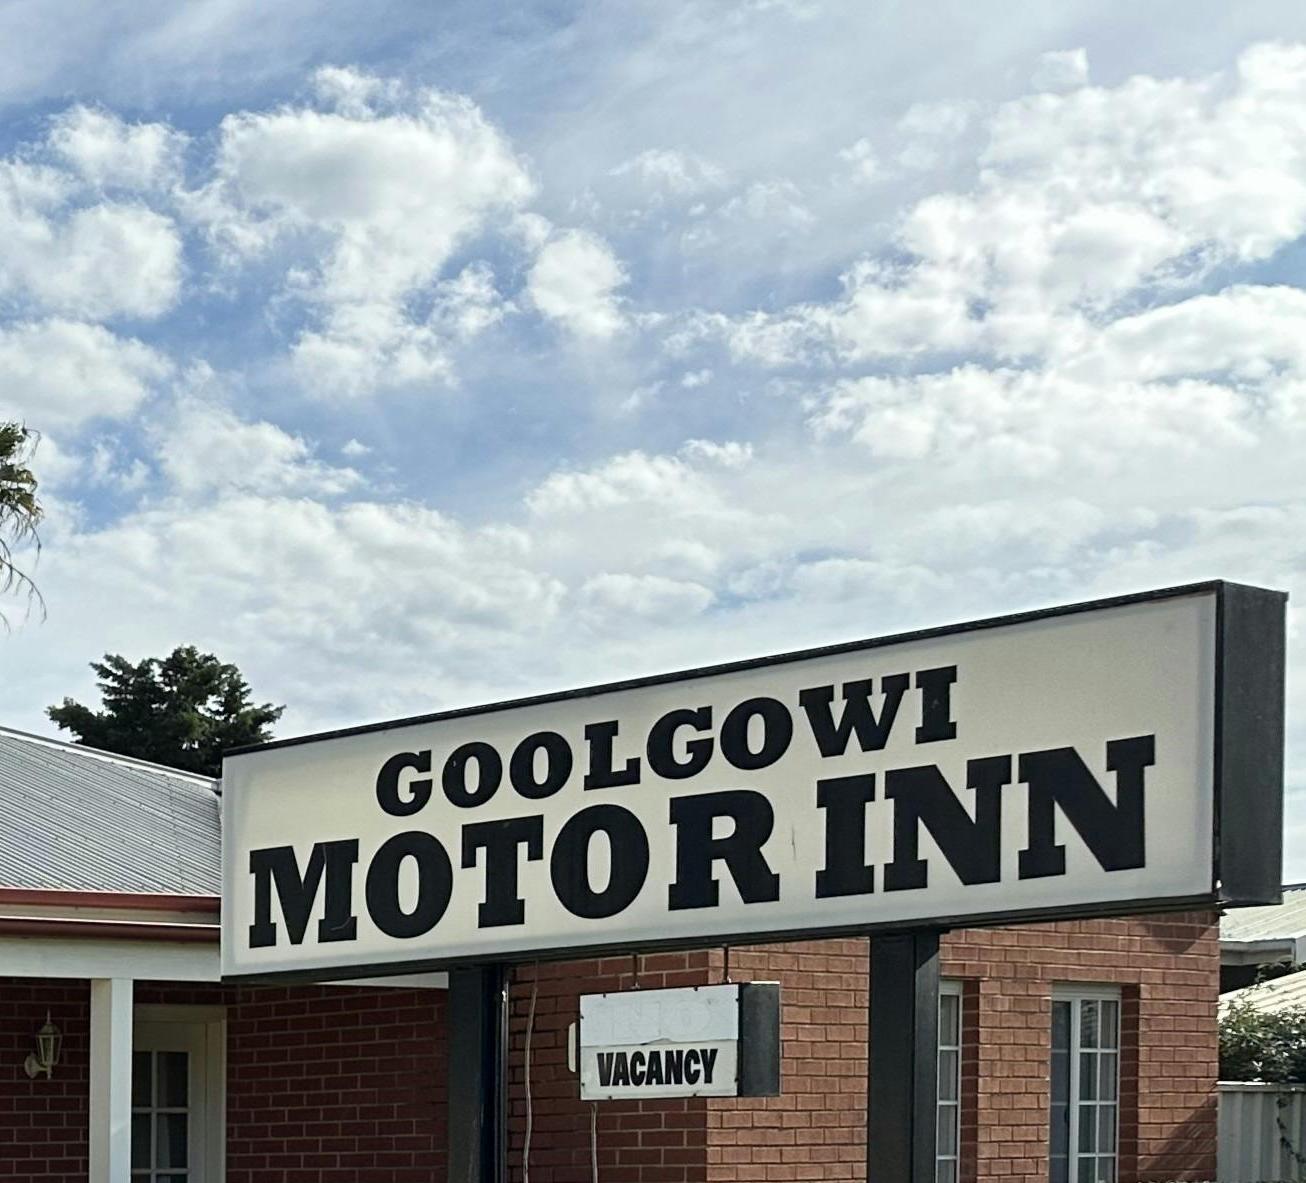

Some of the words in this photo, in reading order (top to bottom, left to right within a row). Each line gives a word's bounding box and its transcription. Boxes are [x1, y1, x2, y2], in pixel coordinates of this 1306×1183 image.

[375, 664, 958, 817] GOOLGOWI
[248, 789, 780, 949] MOTOR
[815, 734, 1155, 899] INN
[596, 1049, 719, 1087] VACANCY
